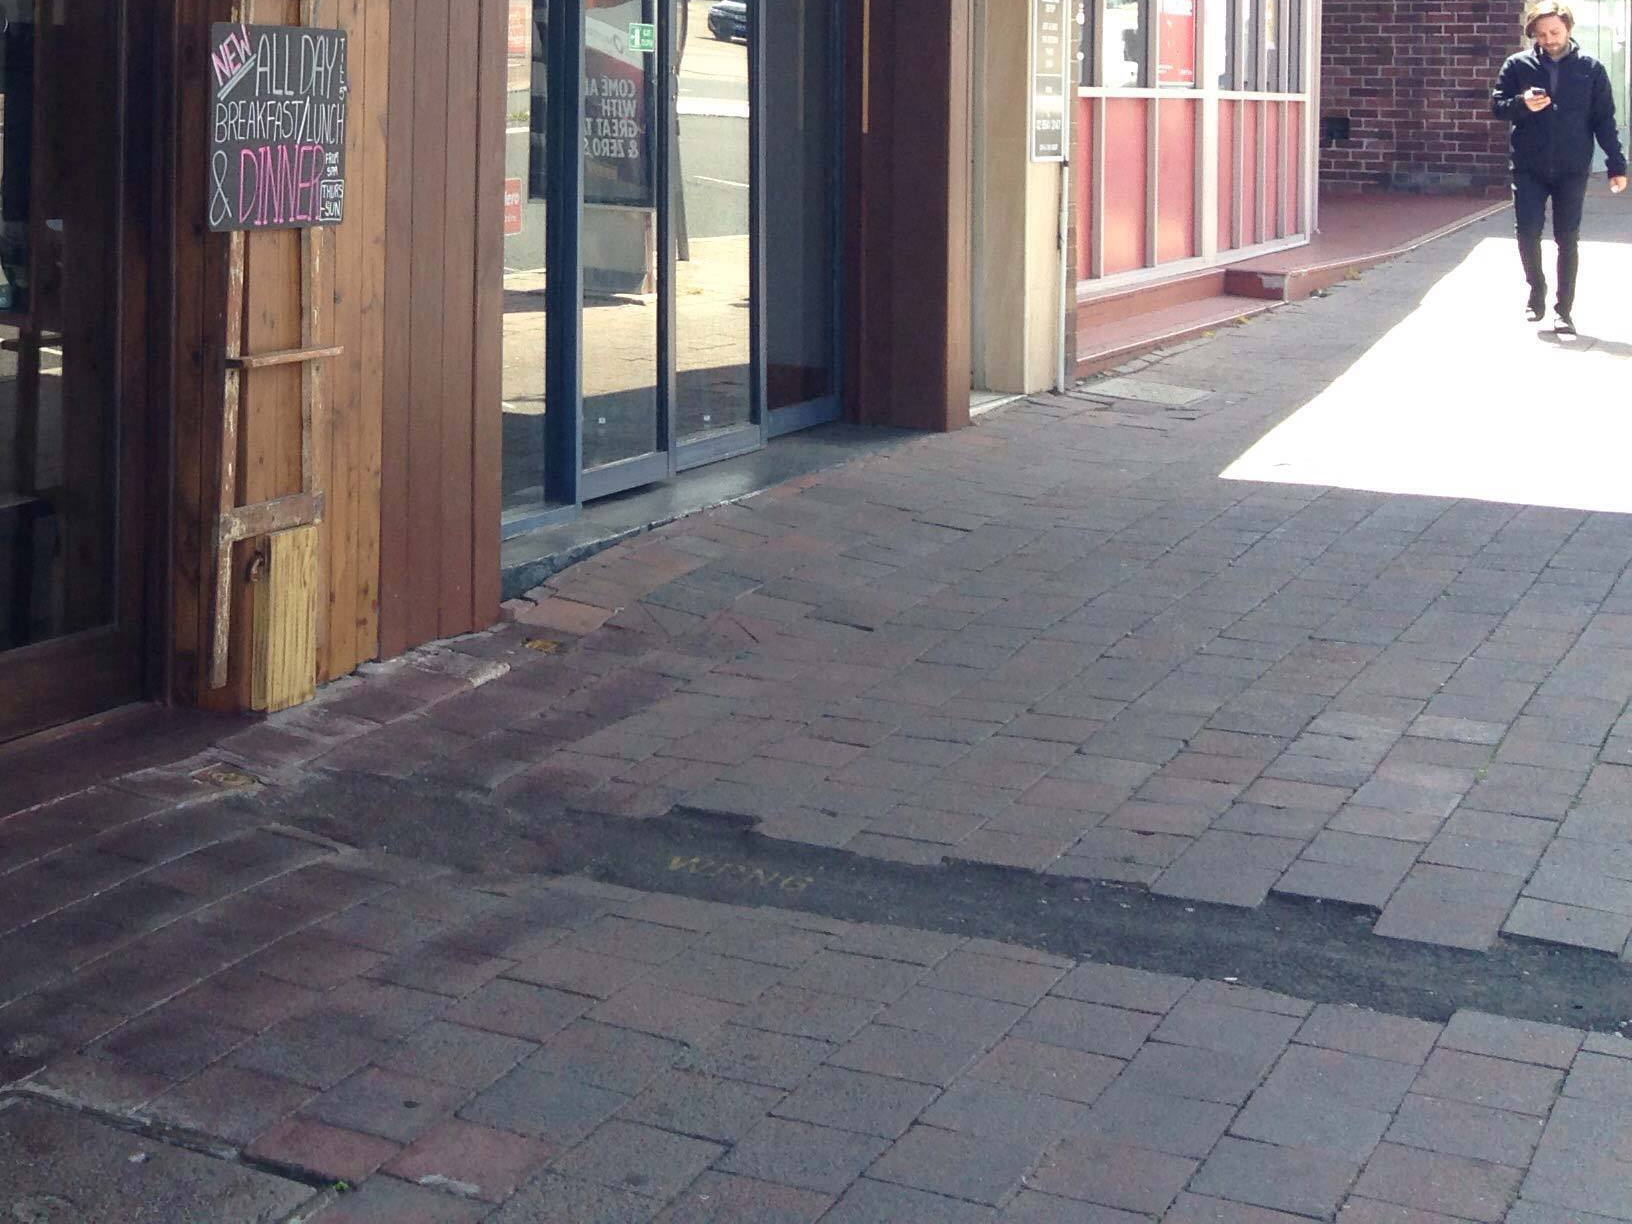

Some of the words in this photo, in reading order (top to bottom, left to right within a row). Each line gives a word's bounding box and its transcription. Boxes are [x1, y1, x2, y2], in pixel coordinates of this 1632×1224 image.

[211, 24, 252, 87] NEW
[255, 33, 294, 97] ALL
[299, 34, 339, 99] DAY
[209, 149, 232, 226] &
[239, 144, 325, 226] DINNER
